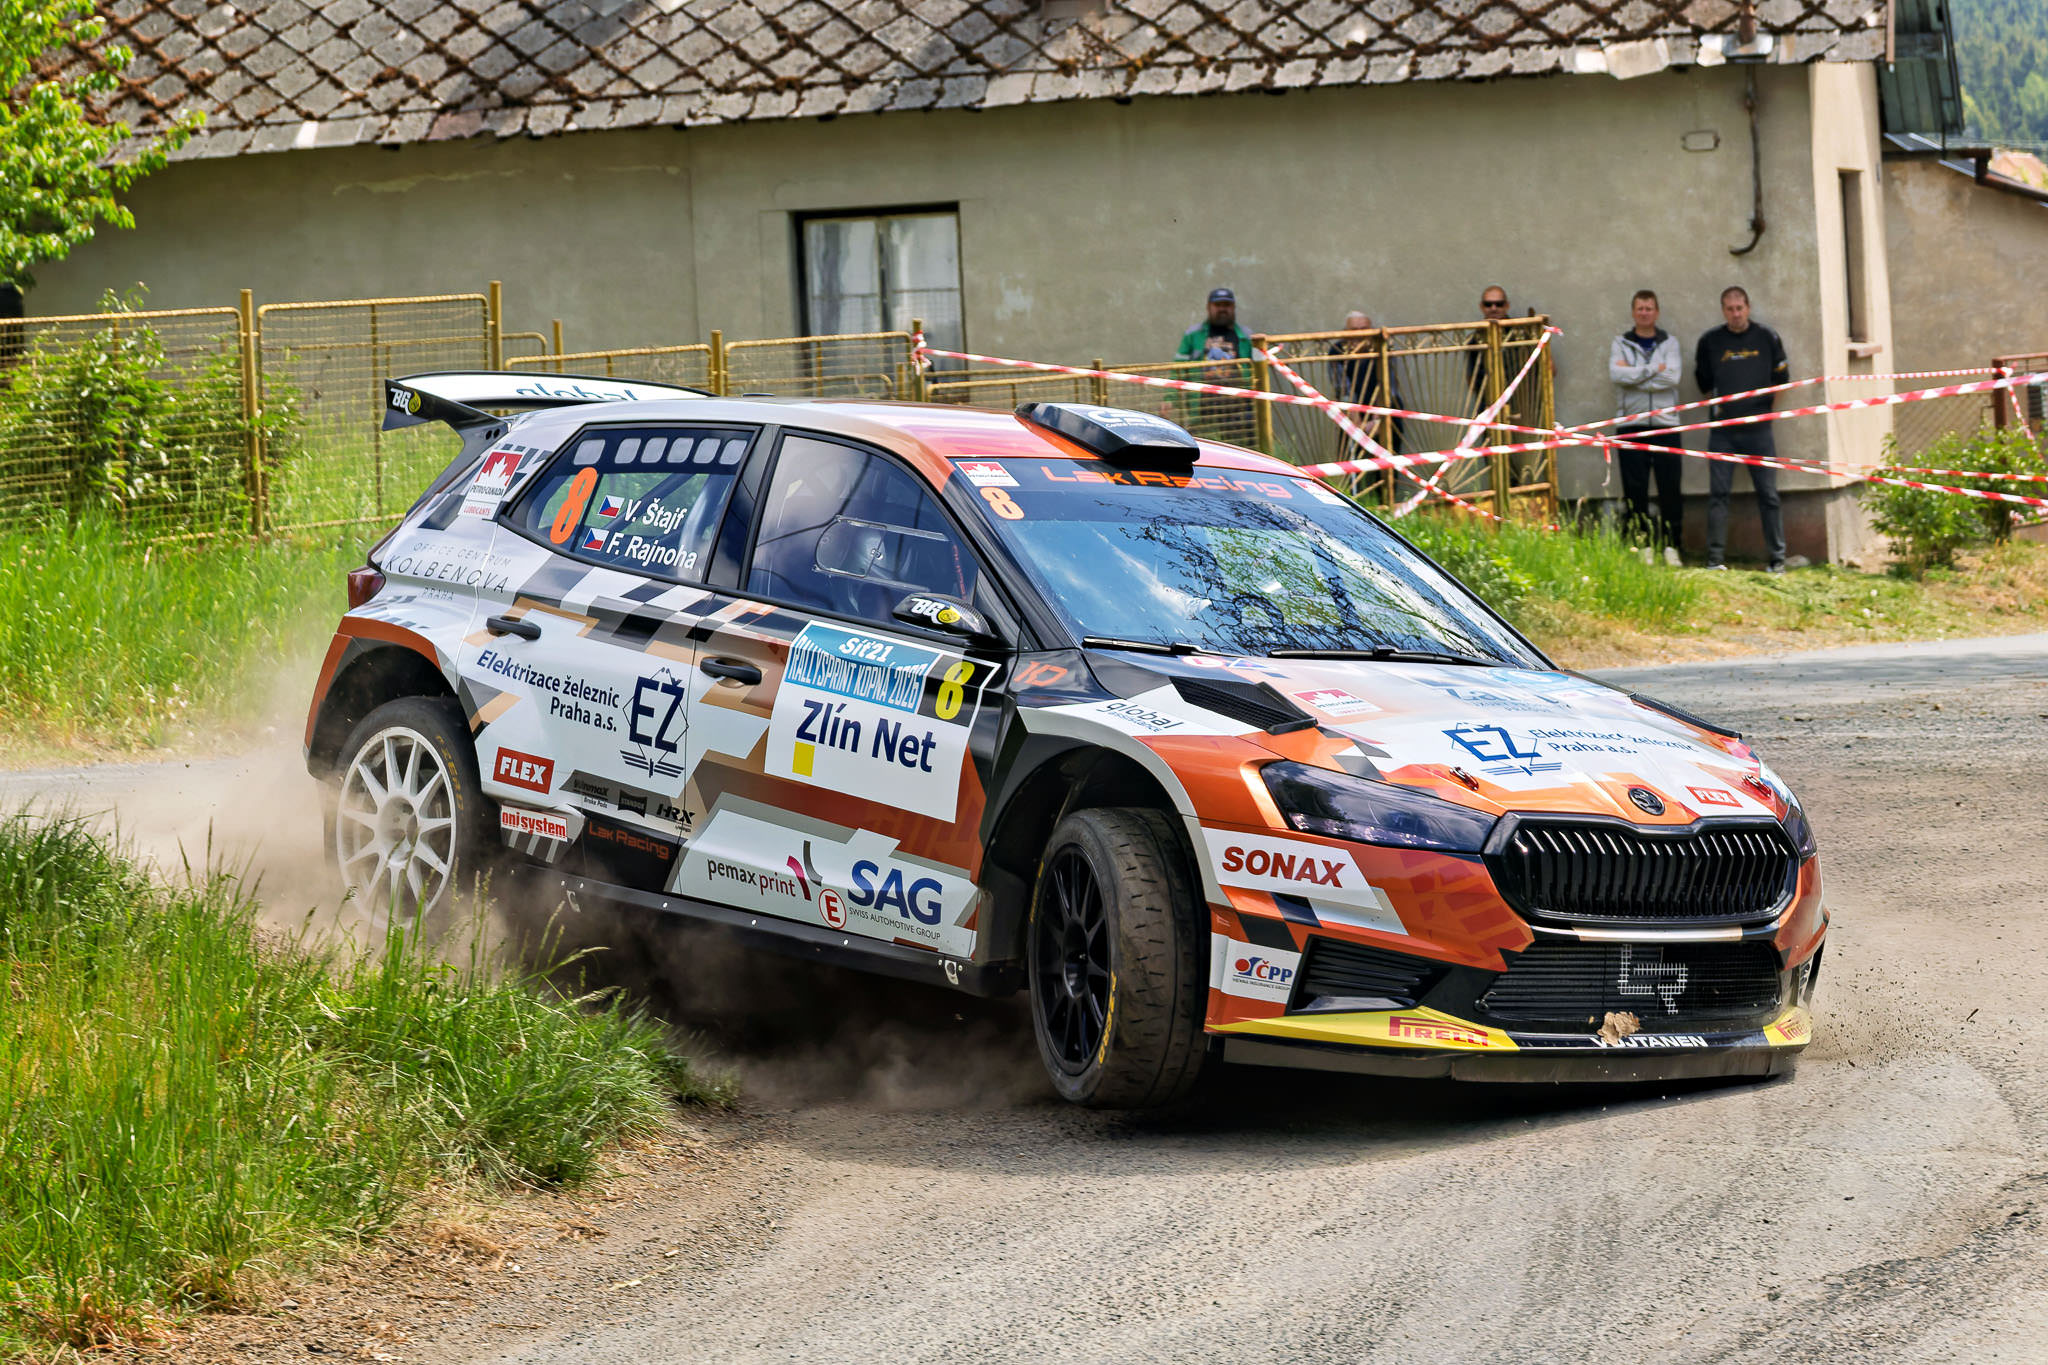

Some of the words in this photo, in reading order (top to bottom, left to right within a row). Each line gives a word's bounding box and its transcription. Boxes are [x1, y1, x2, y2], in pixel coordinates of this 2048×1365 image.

[1041, 466, 1131, 485] Lak
[1131, 470, 1293, 499] Racing
[550, 466, 598, 544] 8
[624, 499, 641, 523] V.
[642, 497, 688, 534] Štajf
[980, 486, 1024, 520] 8
[606, 531, 624, 555] F.
[624, 535, 698, 570] Rajnoha
[385, 555, 509, 593] KOLBENOVA
[911, 597, 946, 625] BG
[476, 649, 560, 693] Elektrizace
[562, 675, 620, 709] železnic
[787, 634, 858, 694] RALLYSPRINT
[852, 661, 897, 703] KOPNÁ
[935, 661, 976, 720] 8
[550, 697, 591, 725] Praha
[594, 714, 618, 732] a.s.
[629, 676, 685, 754] EŽ
[1096, 702, 1184, 729] global
[796, 699, 862, 754] Zlín
[871, 718, 936, 773] Net
[499, 756, 548, 785] FLEX
[657, 803, 695, 824] HRX
[589, 821, 613, 840] Lak
[616, 830, 669, 860] Racing
[707, 859, 757, 886] pemax
[759, 872, 796, 897] print
[1222, 846, 1346, 888] SONAX
[825, 895, 841, 923] E
[847, 859, 943, 926] SAG
[849, 906, 869, 920] SWISS
[870, 913, 915, 934] AUTOMOTIVE
[915, 927, 941, 941] GROUP
[1256, 960, 1293, 982] ČPP
[1389, 1015, 1489, 1047] PIRELLI
